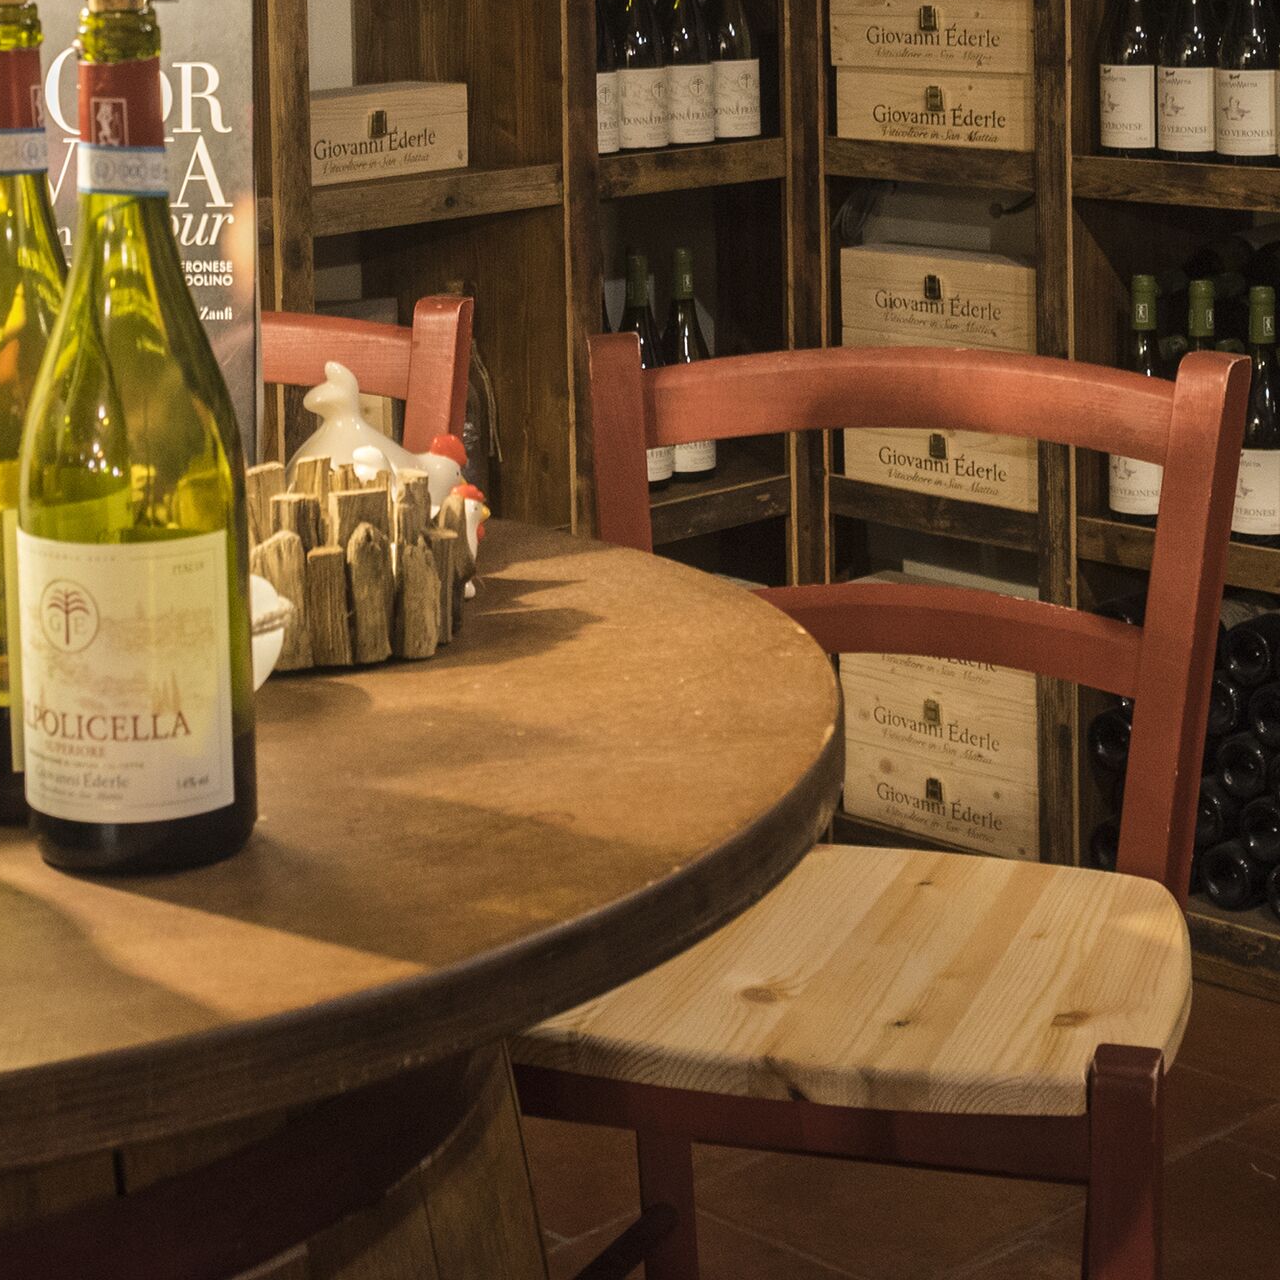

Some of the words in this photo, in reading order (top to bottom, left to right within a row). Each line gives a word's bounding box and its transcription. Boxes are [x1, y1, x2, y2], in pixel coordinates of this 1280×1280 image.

[866, 25, 941, 47] Giovanni
[872, 104, 946, 126] Giovanni
[313, 139, 384, 161] Giovanni
[184, 273, 233, 287] DOLINO
[874, 288, 945, 316] Giovanni
[878, 446, 950, 474] Giovanni
[873, 706, 944, 739] Giovanni
[876, 782, 946, 817] Giovanni
